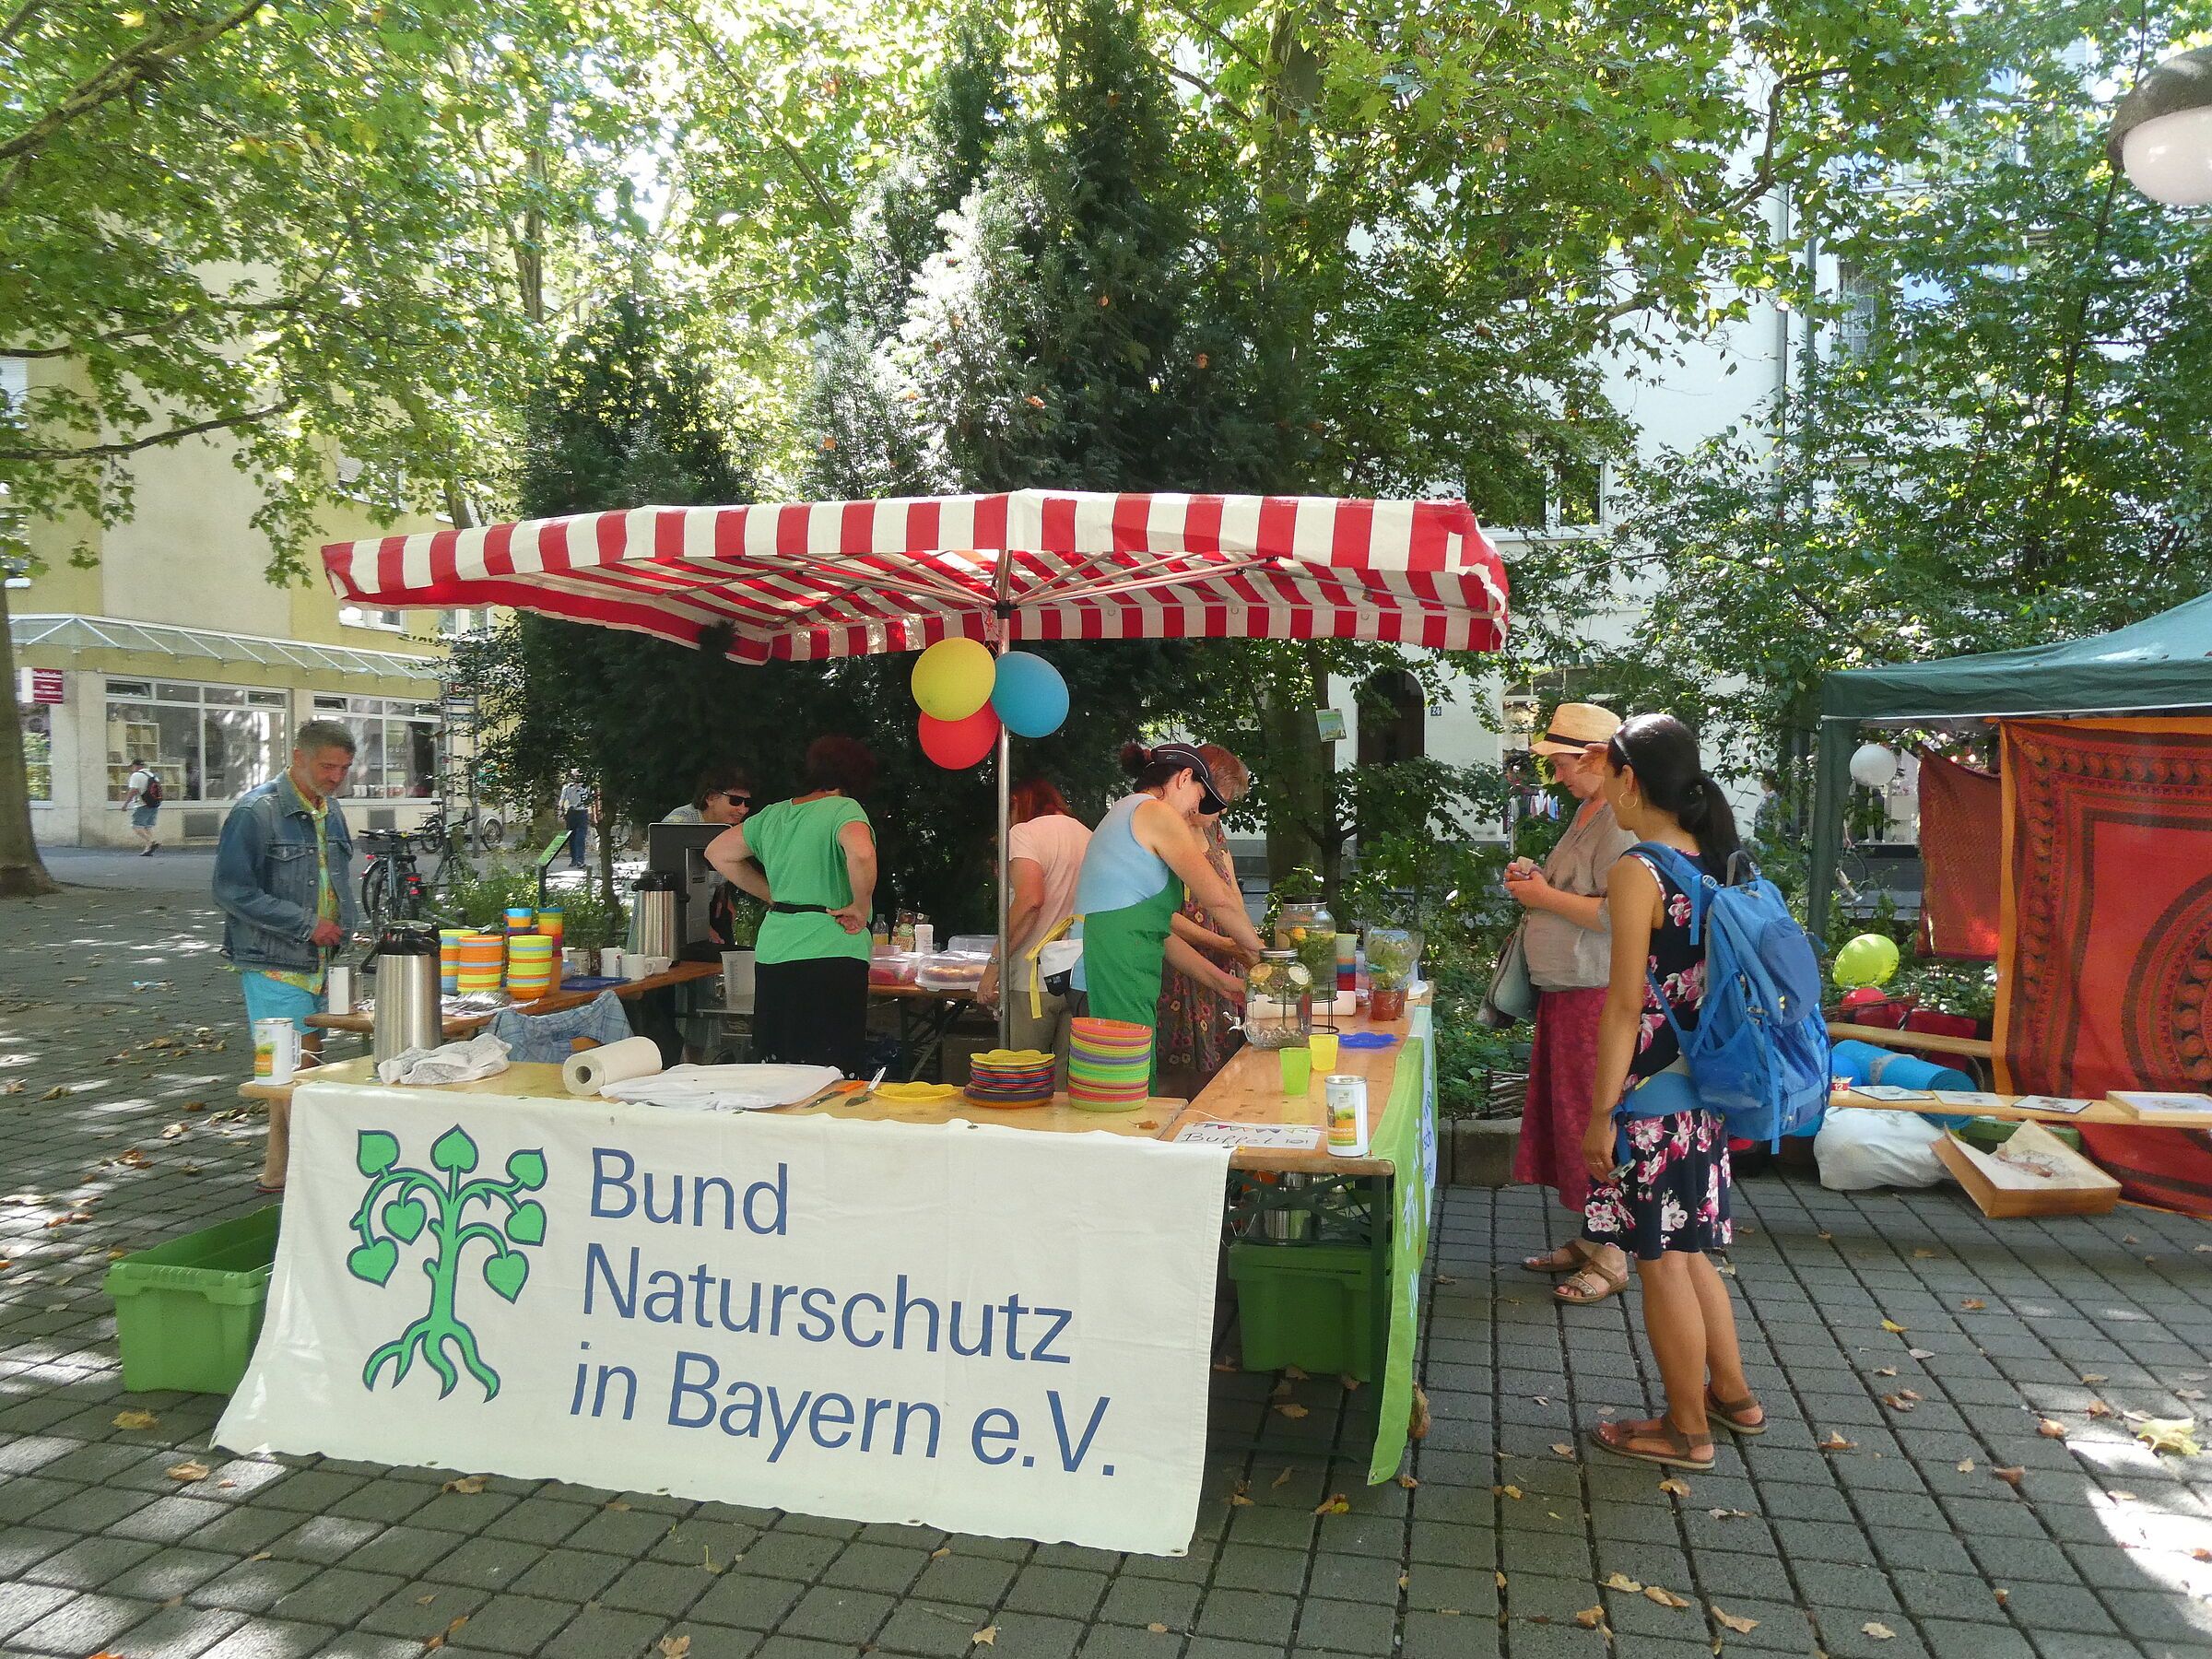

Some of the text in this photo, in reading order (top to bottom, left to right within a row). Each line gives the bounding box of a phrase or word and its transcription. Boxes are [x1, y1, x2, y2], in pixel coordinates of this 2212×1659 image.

[1432, 706, 1441, 715] 24
[590, 1148, 789, 1236] Bund
[584, 1243, 1072, 1364] Naturschutz
[570, 1341, 1114, 1476] in Bayern e.V.
